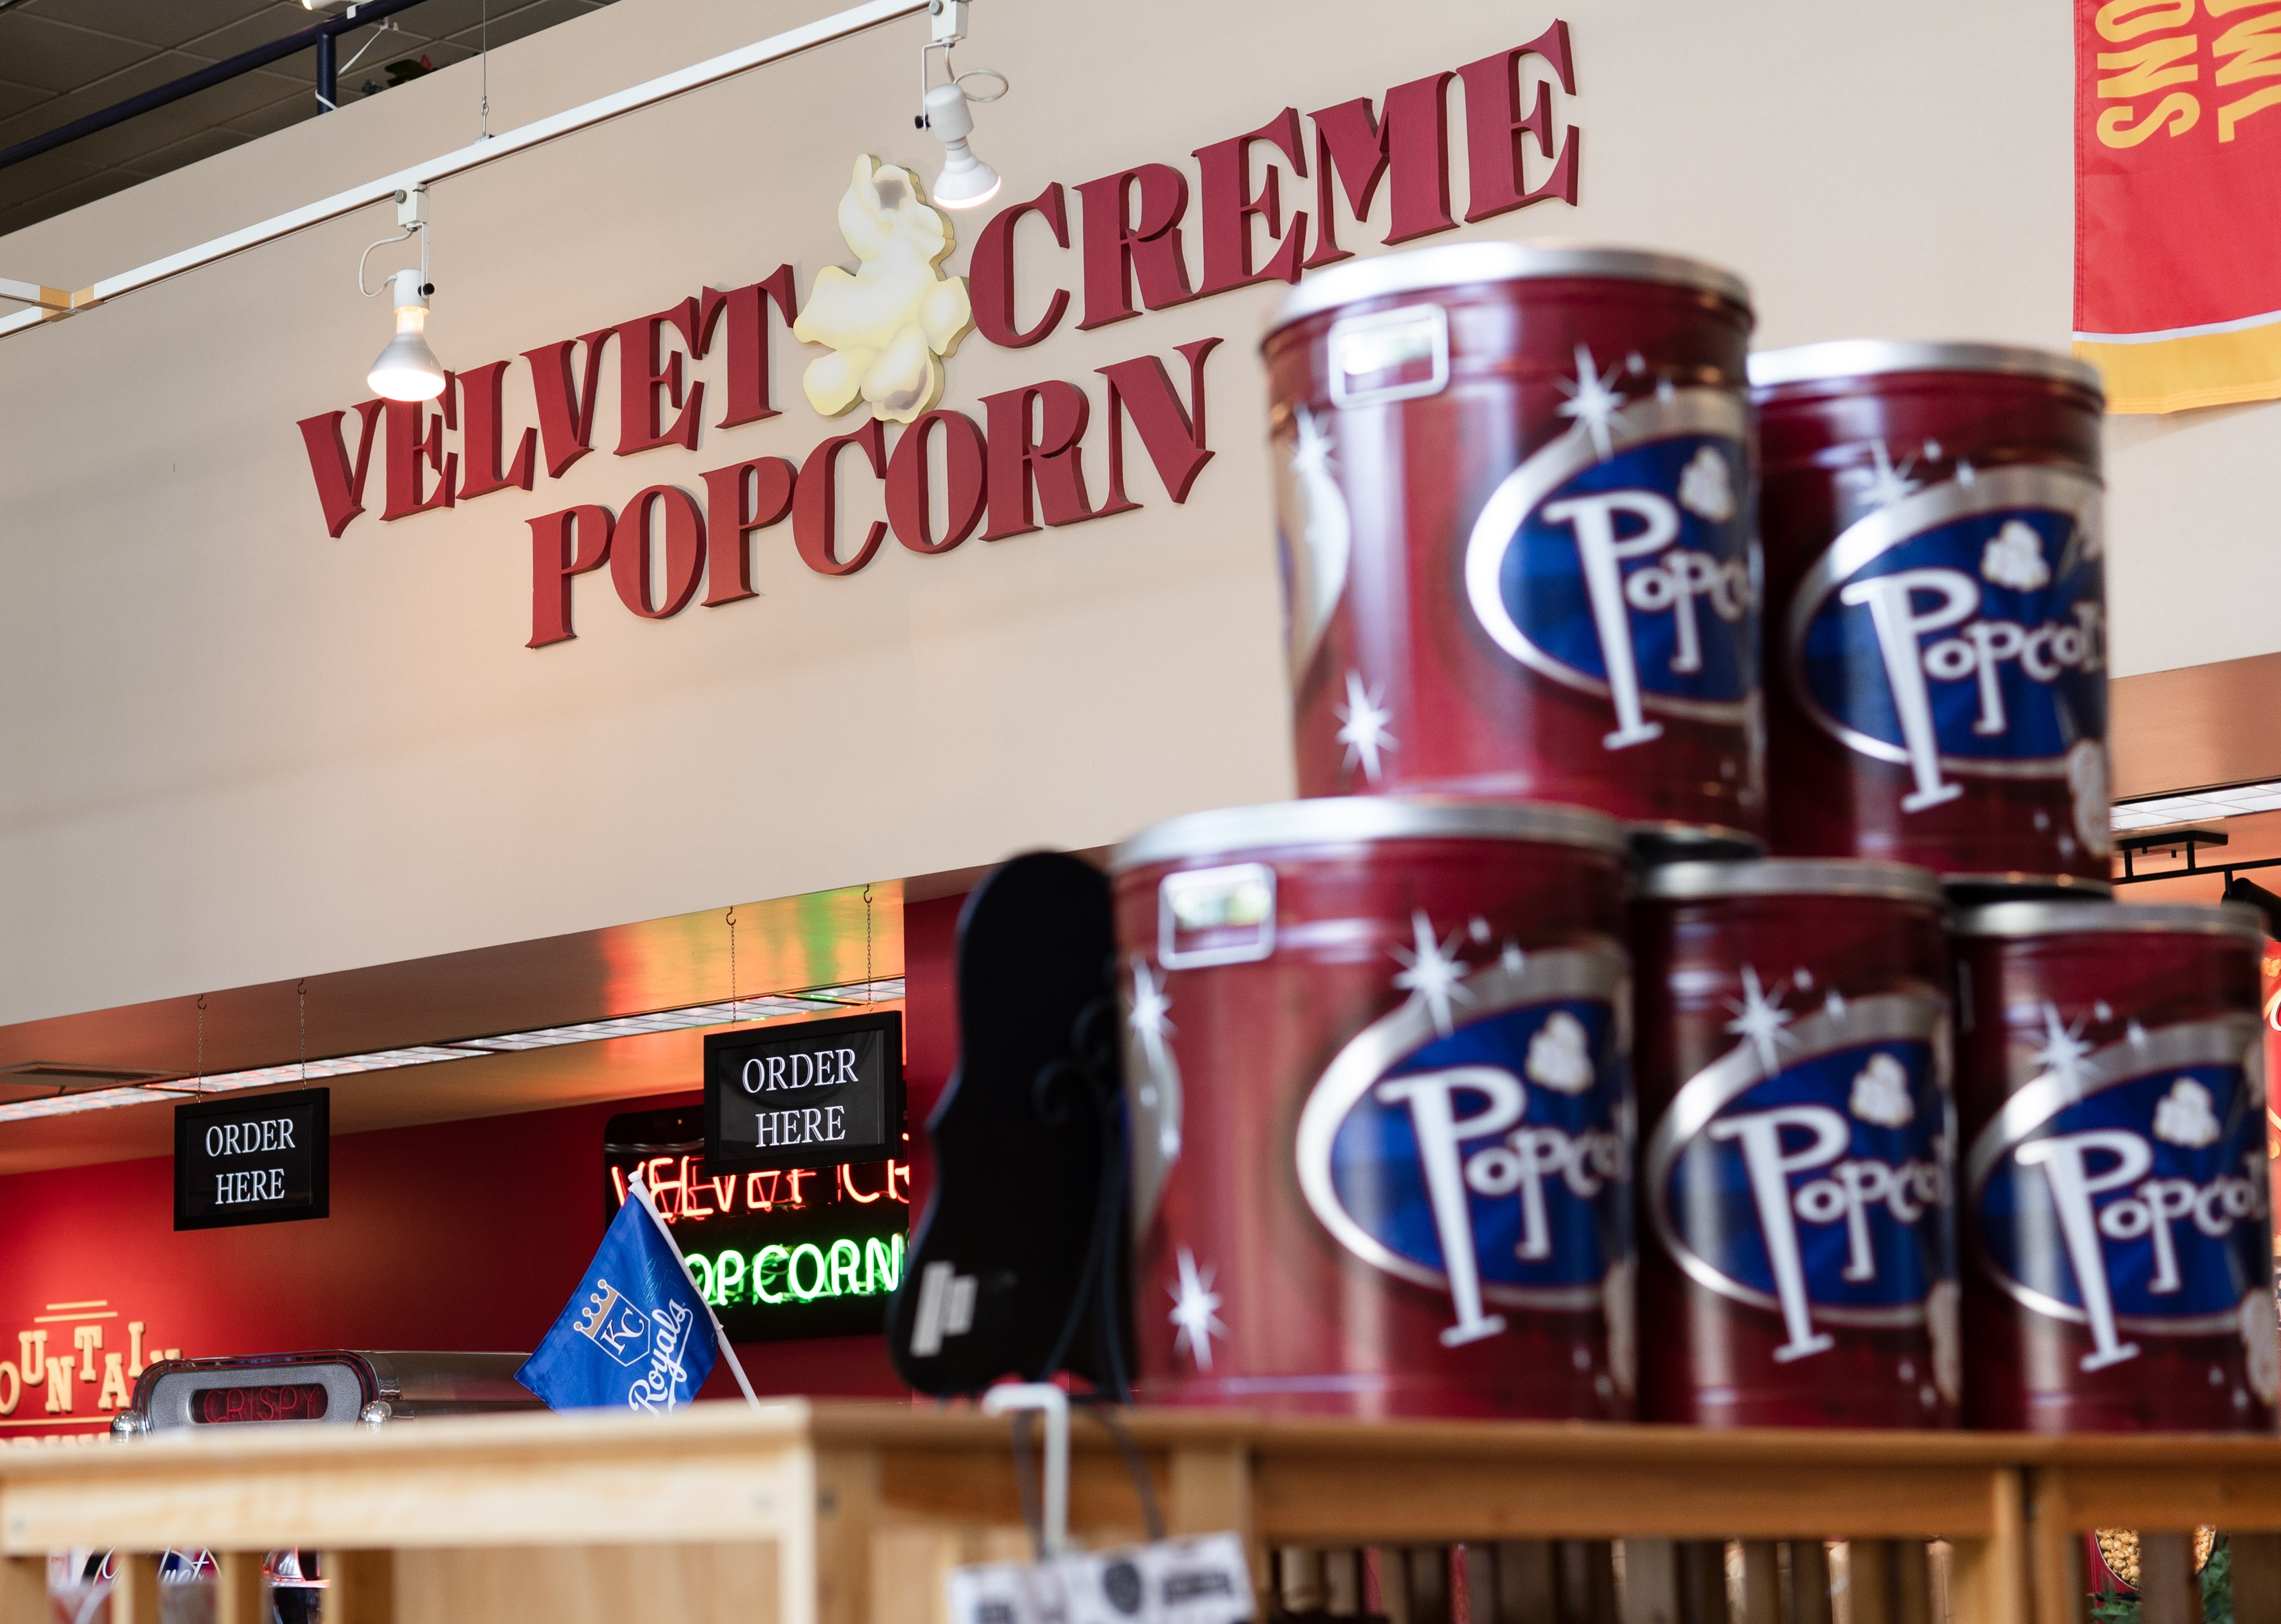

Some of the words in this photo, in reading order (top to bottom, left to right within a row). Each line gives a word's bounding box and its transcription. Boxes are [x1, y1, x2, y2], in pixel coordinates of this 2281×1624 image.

[2203, 0, 2281, 143] WL
[296, 263, 799, 538] VELVET
[969, 17, 1580, 348] CREME
[524, 337, 1224, 649] POPCORN
[742, 1048, 858, 1093] ORDER
[206, 1118, 296, 1157] ORDER
[756, 1106, 846, 1147] HERE
[215, 1169, 285, 1204] HERE
[0, 1321, 182, 1416] OUNTAI
[628, 1299, 693, 1421] Royals
[204, 1383, 318, 1423] CRISPY
